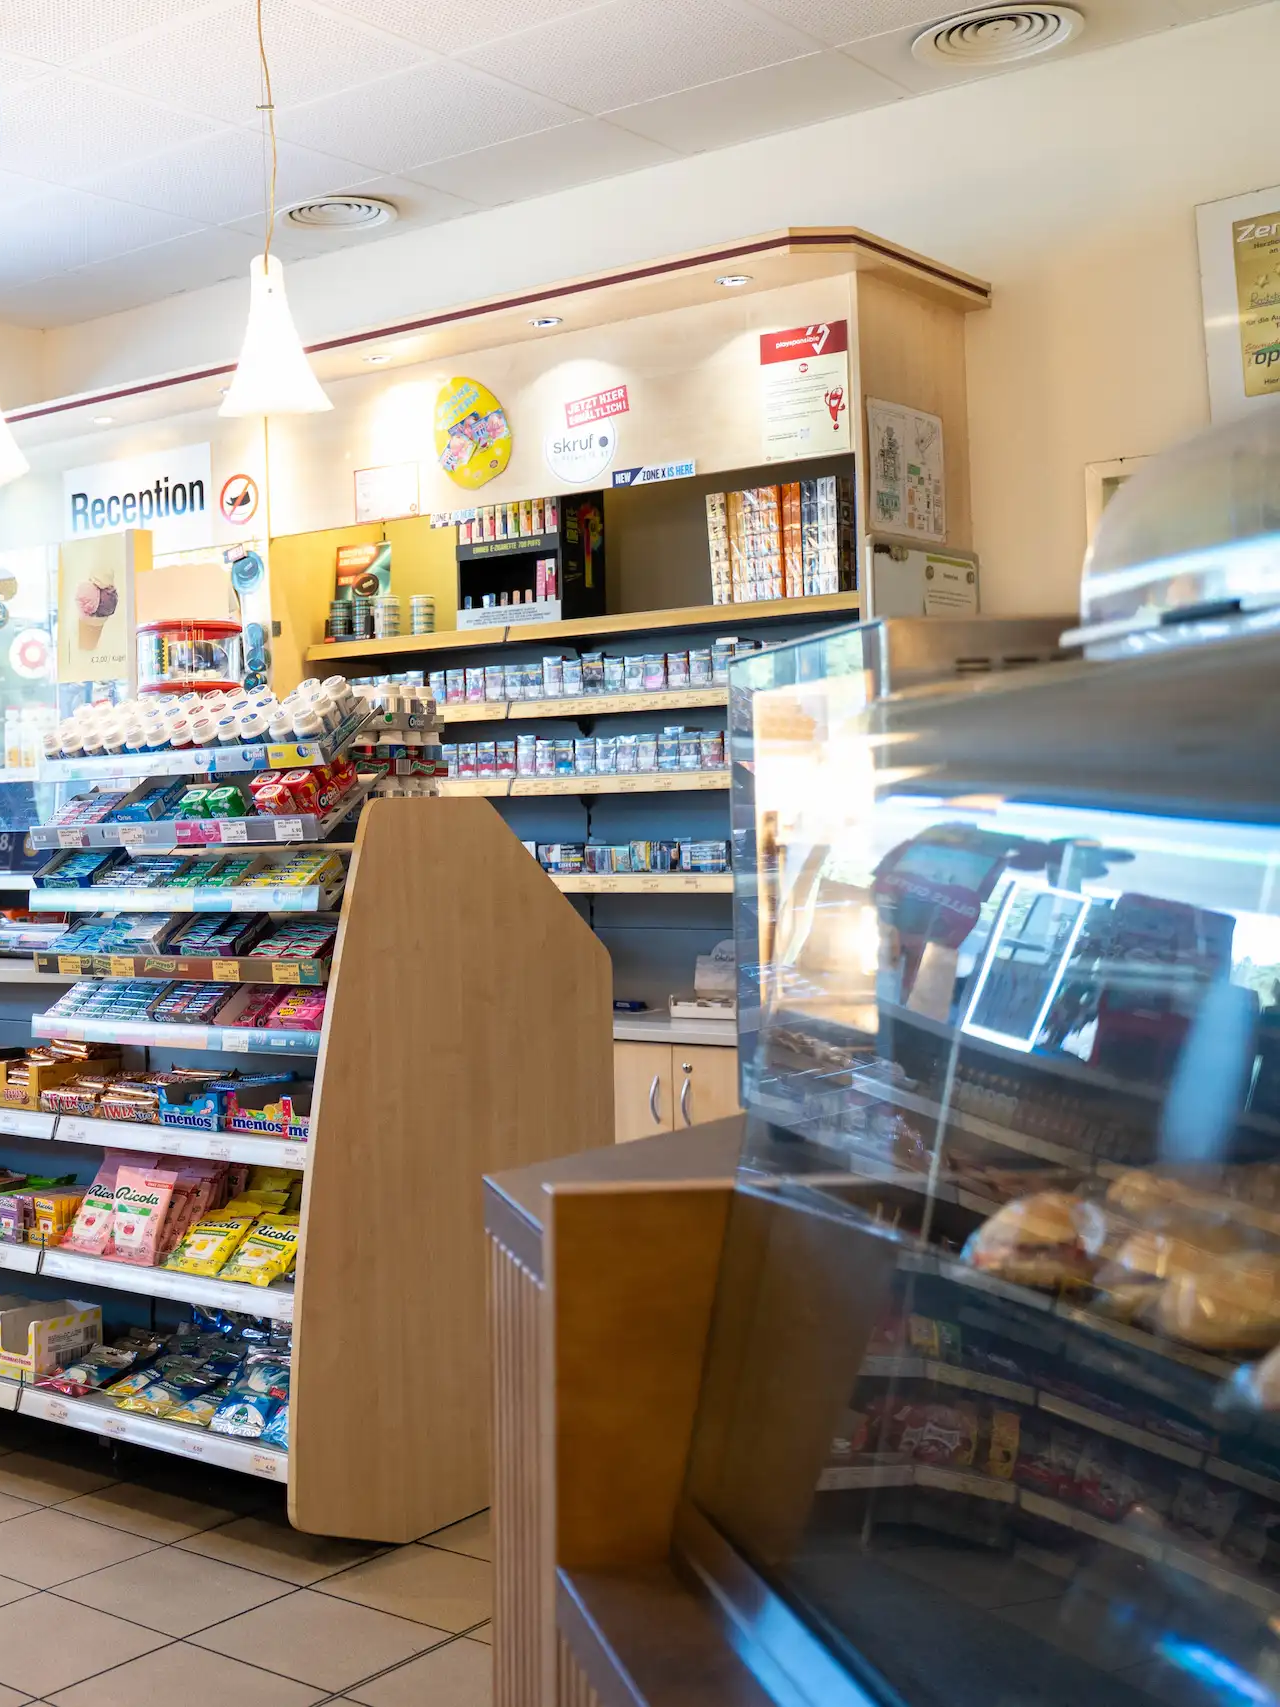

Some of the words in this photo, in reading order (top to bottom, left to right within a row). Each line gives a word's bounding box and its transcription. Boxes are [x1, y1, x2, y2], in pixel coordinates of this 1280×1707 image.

[600, 387, 625, 404] HIER
[553, 433, 593, 455] skruf
[615, 471, 631, 485] NEW
[642, 469, 660, 482] ZONE
[675, 463, 694, 476] HERE
[71, 476, 205, 533] Reception
[409, 714, 425, 728] Orbit
[320, 787, 339, 807] Orbit
[117, 814, 133, 822] Orbit
[152, 1010, 176, 1023] Orbit
[48, 1094, 79, 1110] TWIX
[102, 1104, 136, 1119] TWIX
[163, 1112, 212, 1128] mentos
[232, 1118, 283, 1133] mentos
[116, 1186, 159, 1205] Ricola
[255, 1225, 297, 1242] Ricola
